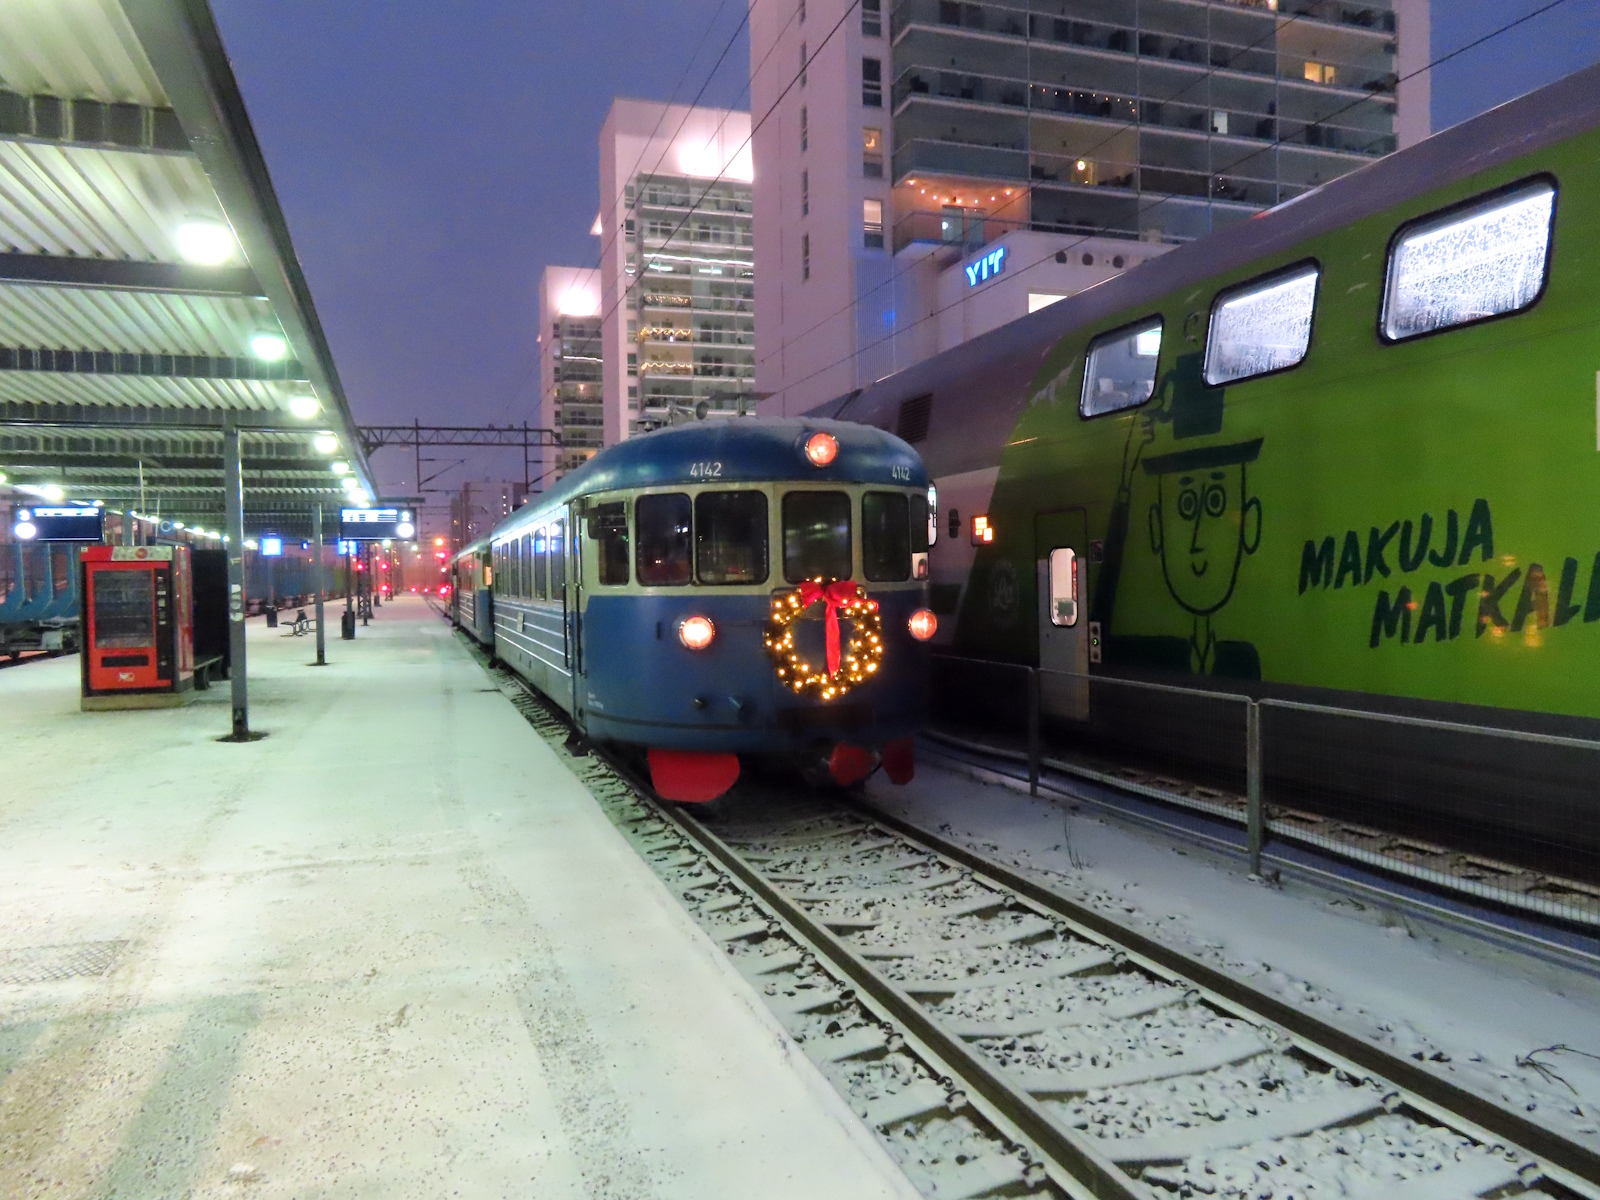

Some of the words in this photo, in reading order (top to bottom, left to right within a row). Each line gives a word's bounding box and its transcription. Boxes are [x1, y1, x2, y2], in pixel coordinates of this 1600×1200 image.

[965, 247, 1004, 287] YIT
[690, 461, 722, 477] 4142
[892, 465, 911, 481] 4142
[1299, 498, 1494, 595] MAKUJA
